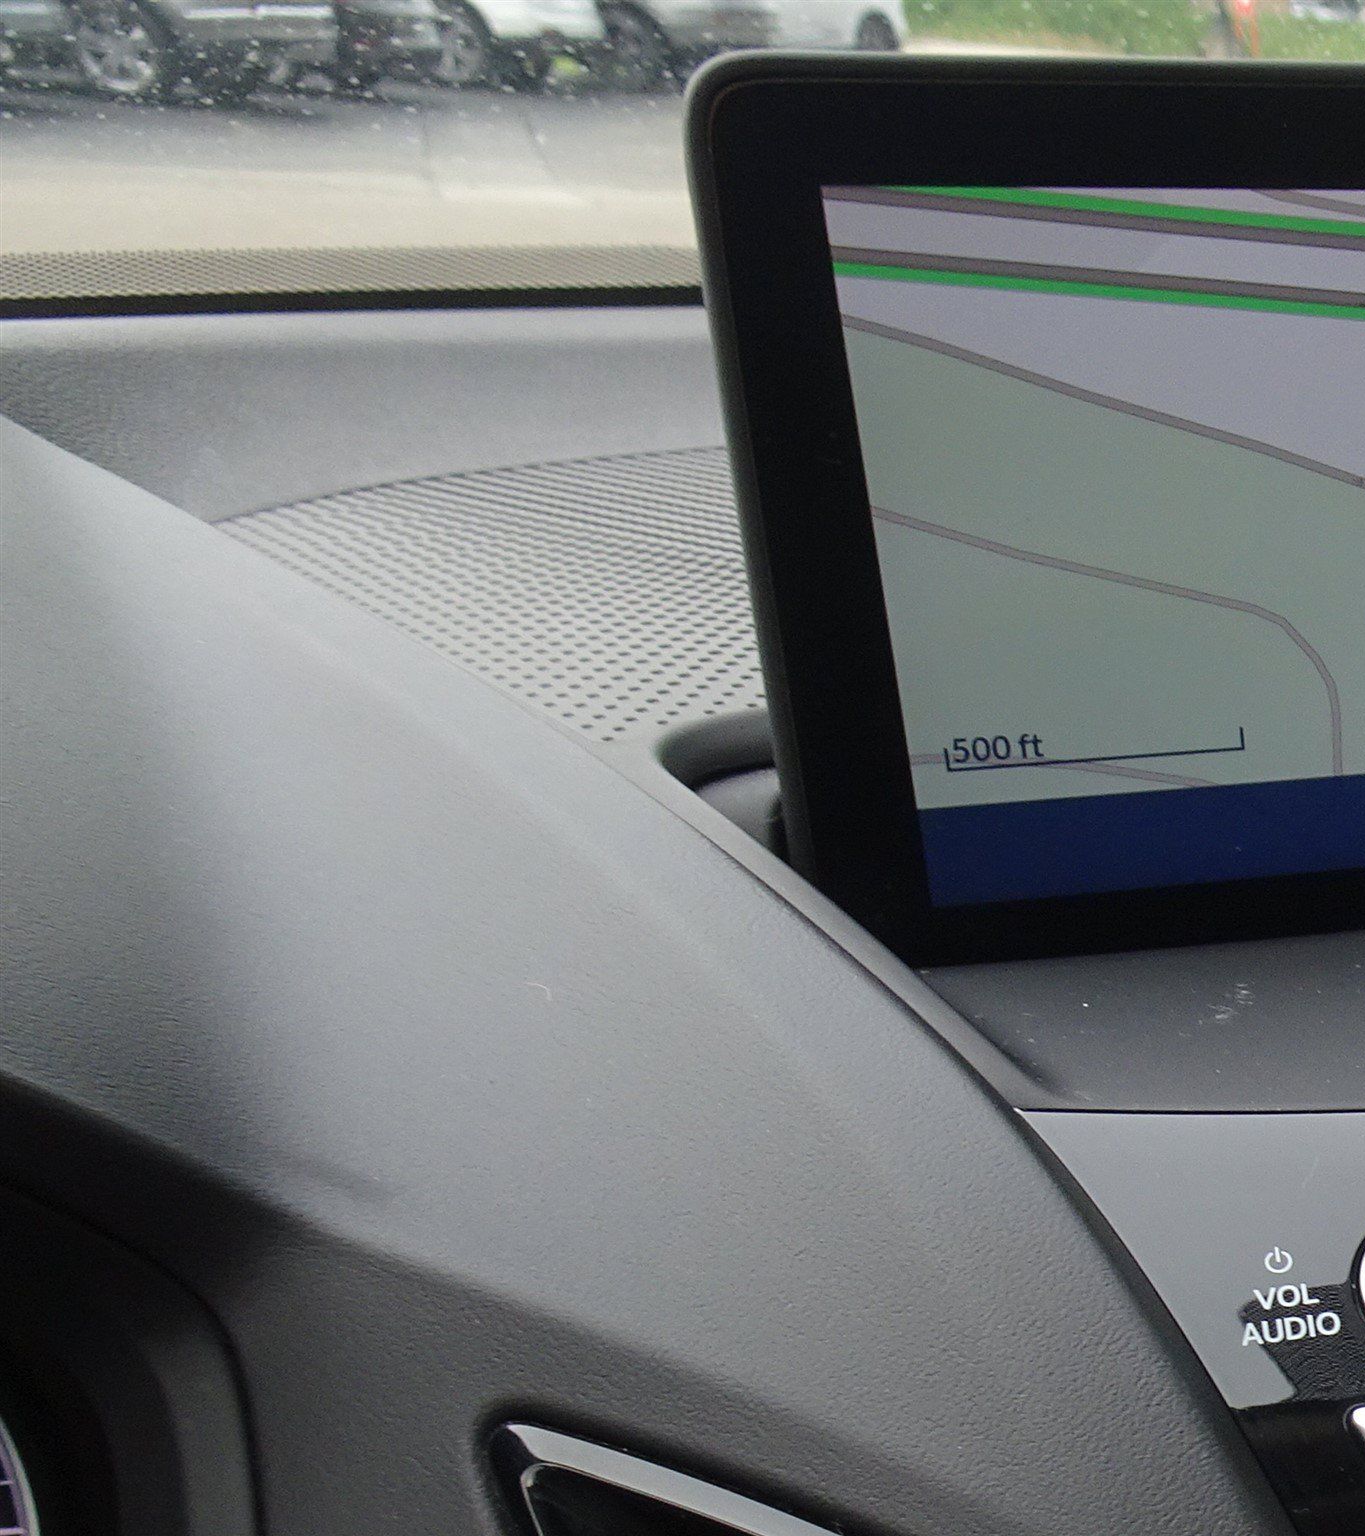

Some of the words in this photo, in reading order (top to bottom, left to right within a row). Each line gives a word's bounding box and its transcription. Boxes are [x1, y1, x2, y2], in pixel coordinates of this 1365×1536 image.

[952, 734, 1011, 764] 500
[1018, 733, 1045, 759] ft
[1252, 1282, 1321, 1311] VOL
[1241, 1311, 1342, 1347] AUDIO
